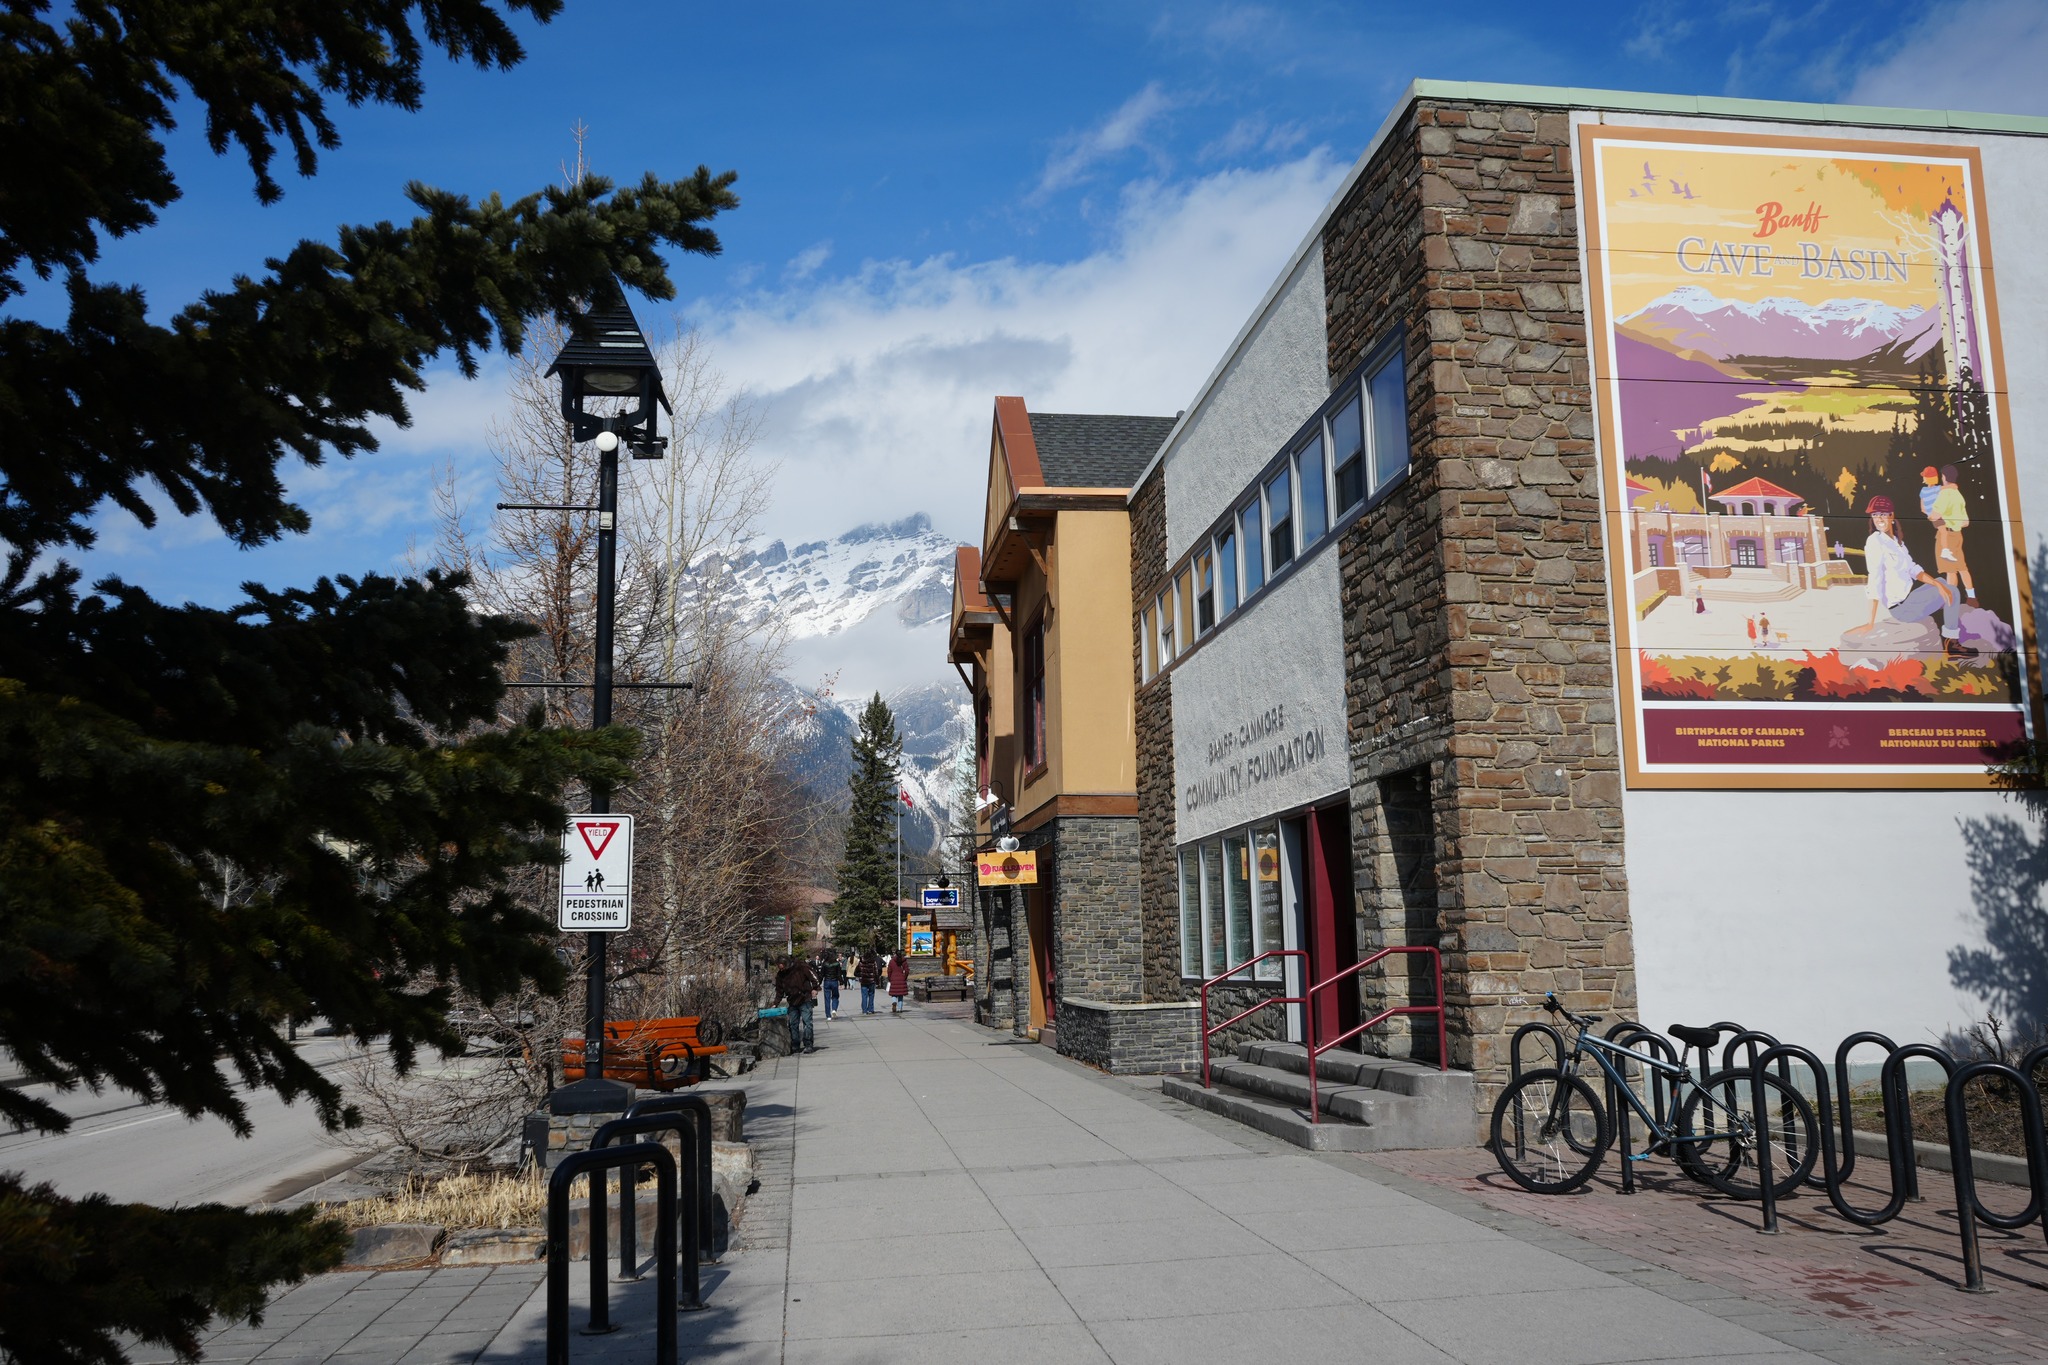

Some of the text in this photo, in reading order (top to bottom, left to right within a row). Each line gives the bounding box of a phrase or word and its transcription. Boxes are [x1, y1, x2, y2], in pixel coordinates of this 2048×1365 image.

[1752, 201, 1829, 238] Banff
[1676, 236, 1909, 282] CAVE AND BASIN
[1675, 727, 1739, 736] BIRTHPLACE
[1755, 728, 1805, 736] CANADA'S
[1888, 728, 1987, 737] BERCEAU DES PARCS
[1697, 739, 1785, 747] NATIONAL PARKS
[1880, 740, 1997, 748] NATIONAUX DU CANADA
[1185, 725, 1326, 812] COMMUNITY FOUNDATION
[588, 829, 608, 837] YIELD
[566, 899, 624, 909] PEDESTRIAN
[571, 911, 618, 921] CROSSING
